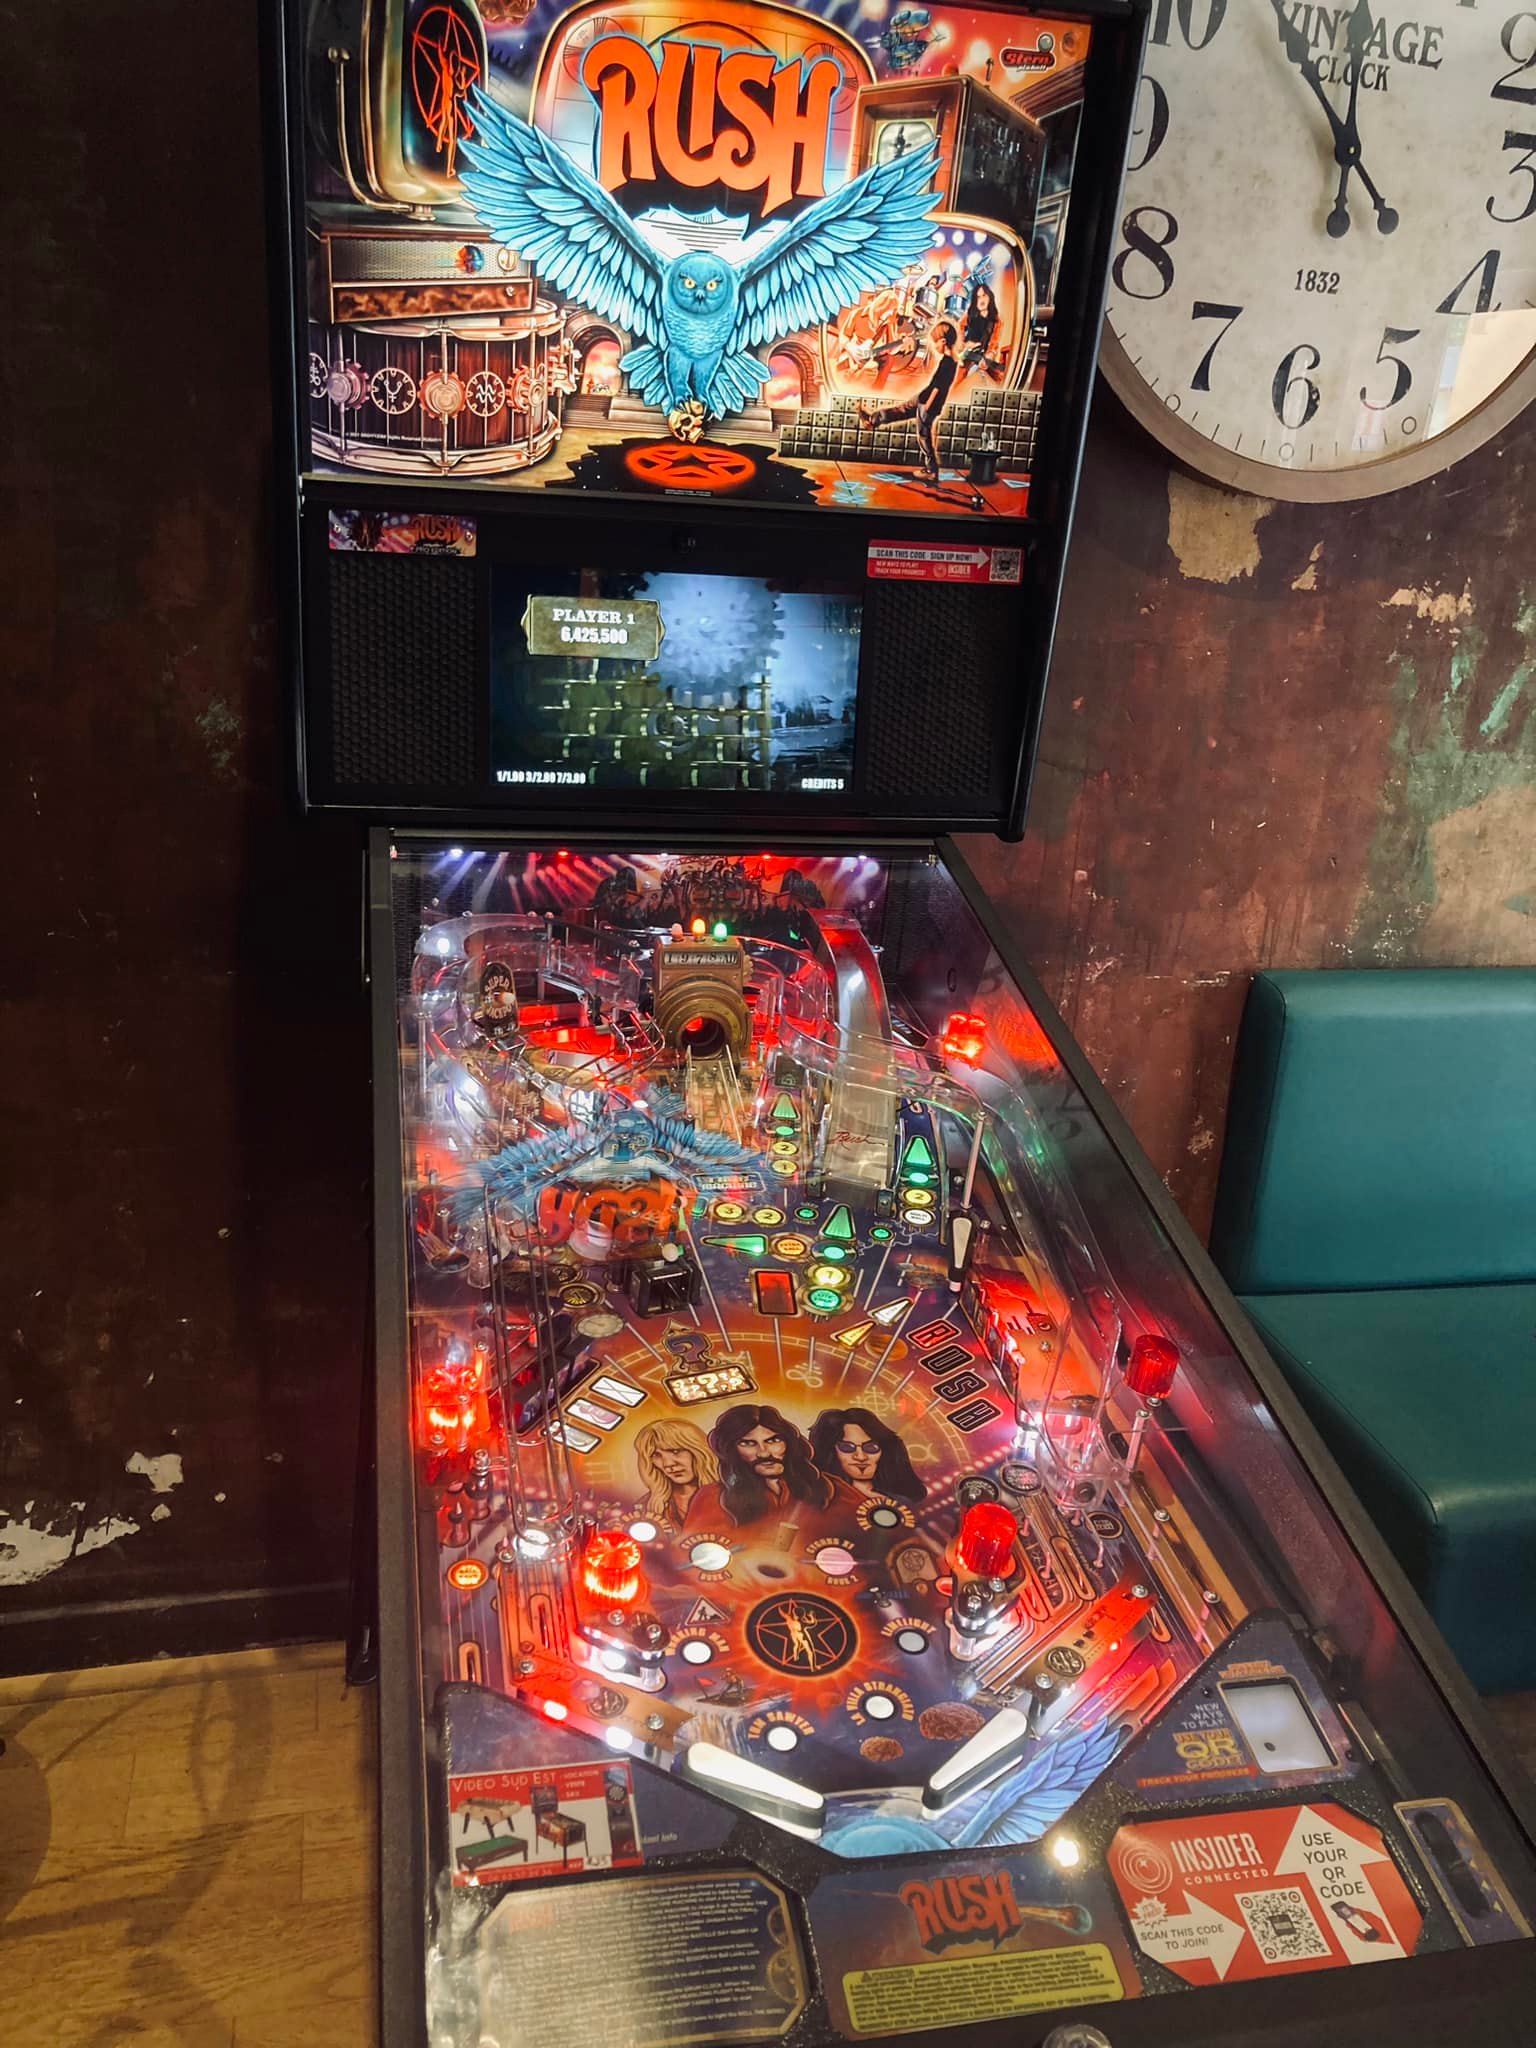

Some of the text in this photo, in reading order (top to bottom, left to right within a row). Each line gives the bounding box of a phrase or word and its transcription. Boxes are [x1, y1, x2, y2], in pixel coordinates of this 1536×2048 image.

[1490, 12, 1536, 105] 2
[583, 36, 838, 217] RUSH
[1486, 130, 1536, 223] 3
[1112, 206, 1178, 299] 8
[1294, 269, 1340, 295] 1832
[1435, 249, 1502, 316] 4
[1191, 301, 1243, 391] 7
[1360, 327, 1420, 410] 5
[1272, 344, 1320, 429] 6
[552, 608, 636, 624] PLAYER 1
[1190, 1711, 1223, 1720] WAYS
[1195, 1702, 1219, 1711] NEW
[1182, 1721, 1197, 1729] TO
[1176, 1738, 1239, 1760] QR
[1302, 1832, 1334, 1847] USE
[1170, 1833, 1264, 1873] INSIDER
[1303, 1848, 1348, 1865] YOUR
[1184, 1868, 1269, 1885] CONNECTED
[1322, 1866, 1346, 1883] QR
[1320, 1881, 1366, 1899] CODE
[901, 1871, 1021, 1950] RUSH
[1141, 1924, 1225, 1941] SCAN THIS CODE
[1166, 1937, 1209, 1950] TO JOIN!
